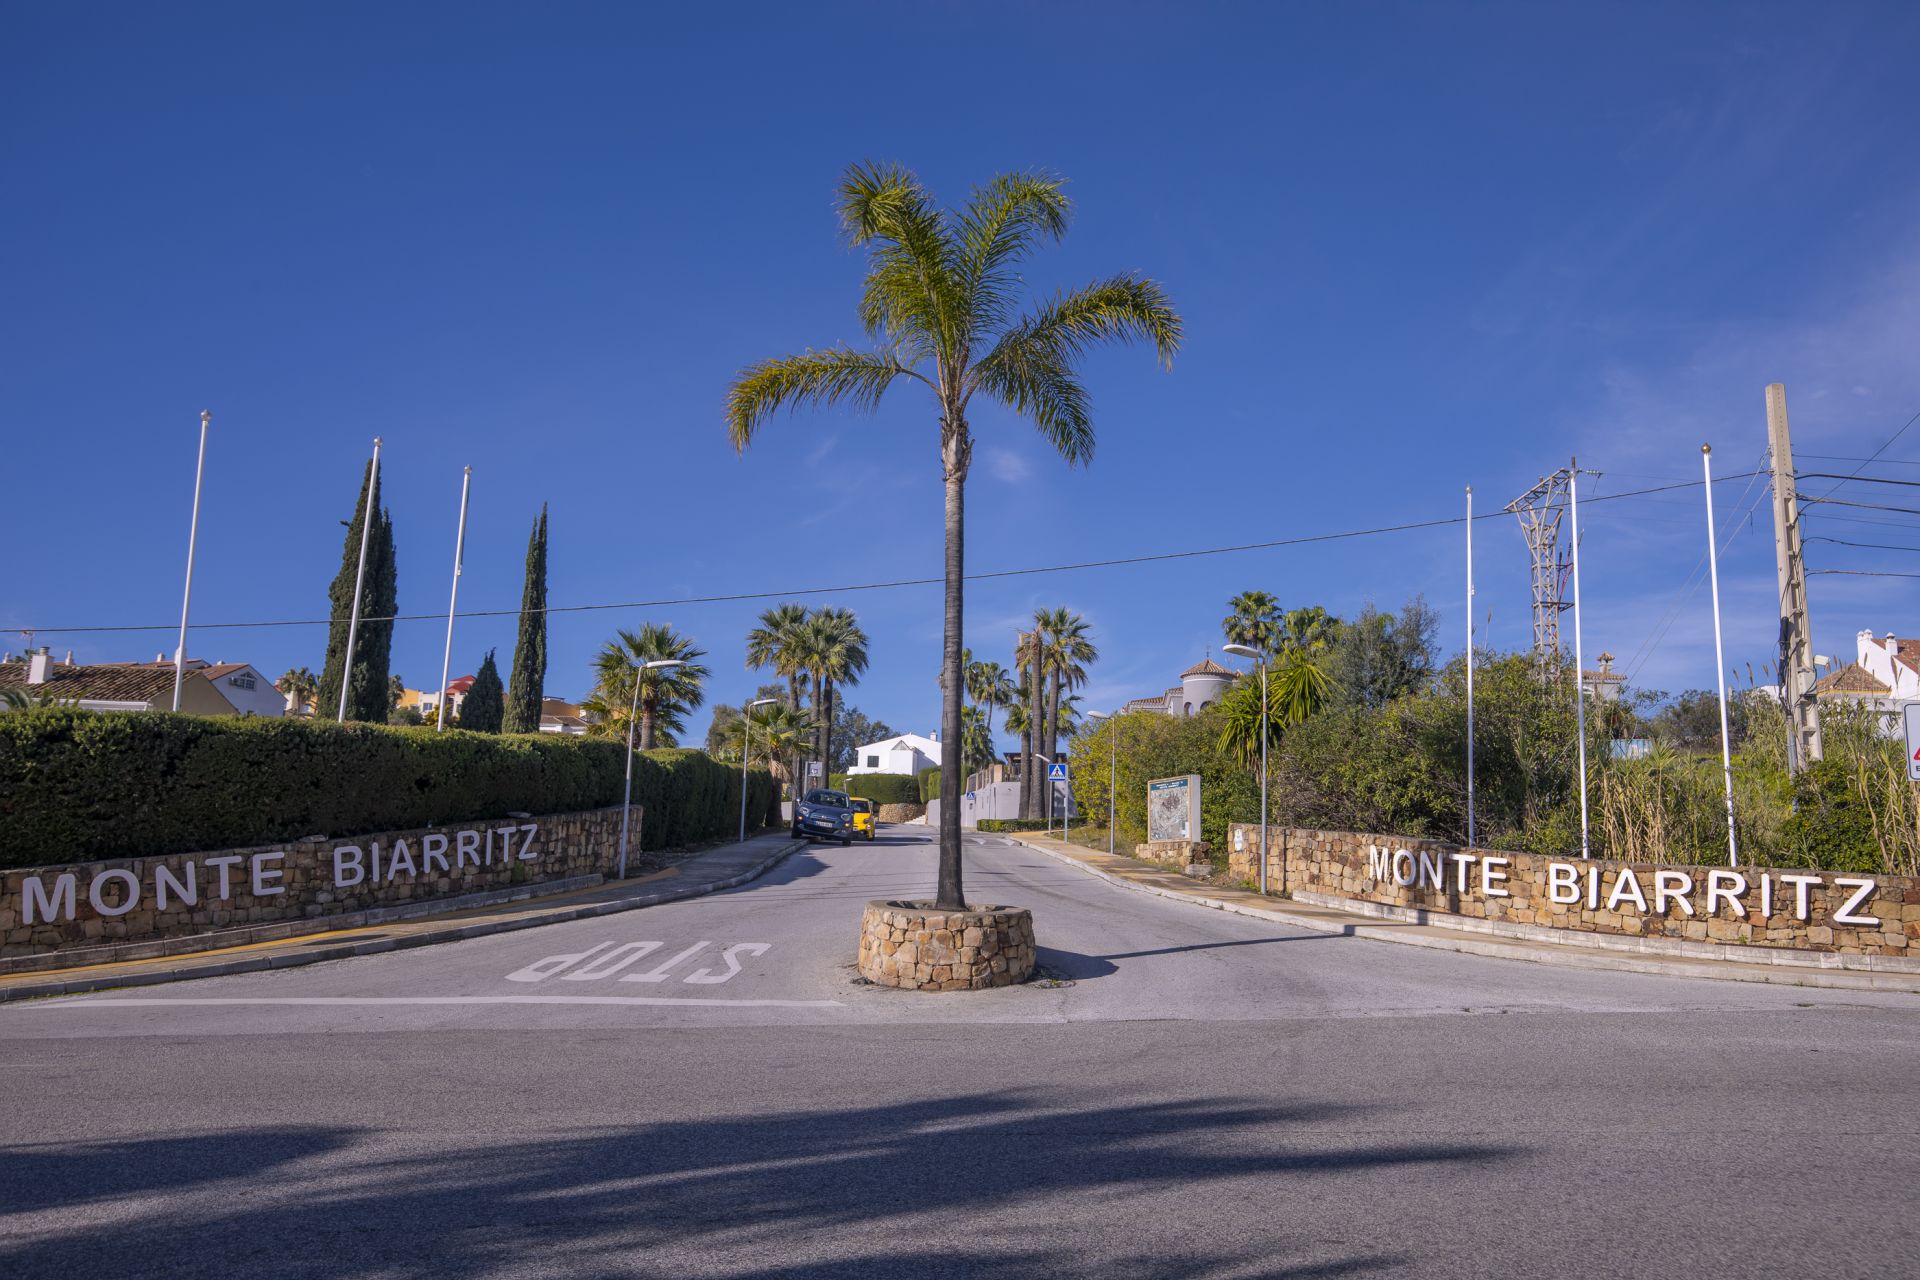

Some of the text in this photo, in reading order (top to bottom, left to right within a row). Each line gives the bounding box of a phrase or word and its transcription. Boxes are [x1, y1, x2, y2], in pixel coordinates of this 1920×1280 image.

[22, 824, 538, 925] MONTE BIARRITZ
[1369, 844, 1880, 925] MONTE BIARRITZ
[504, 941, 772, 984] STOP
